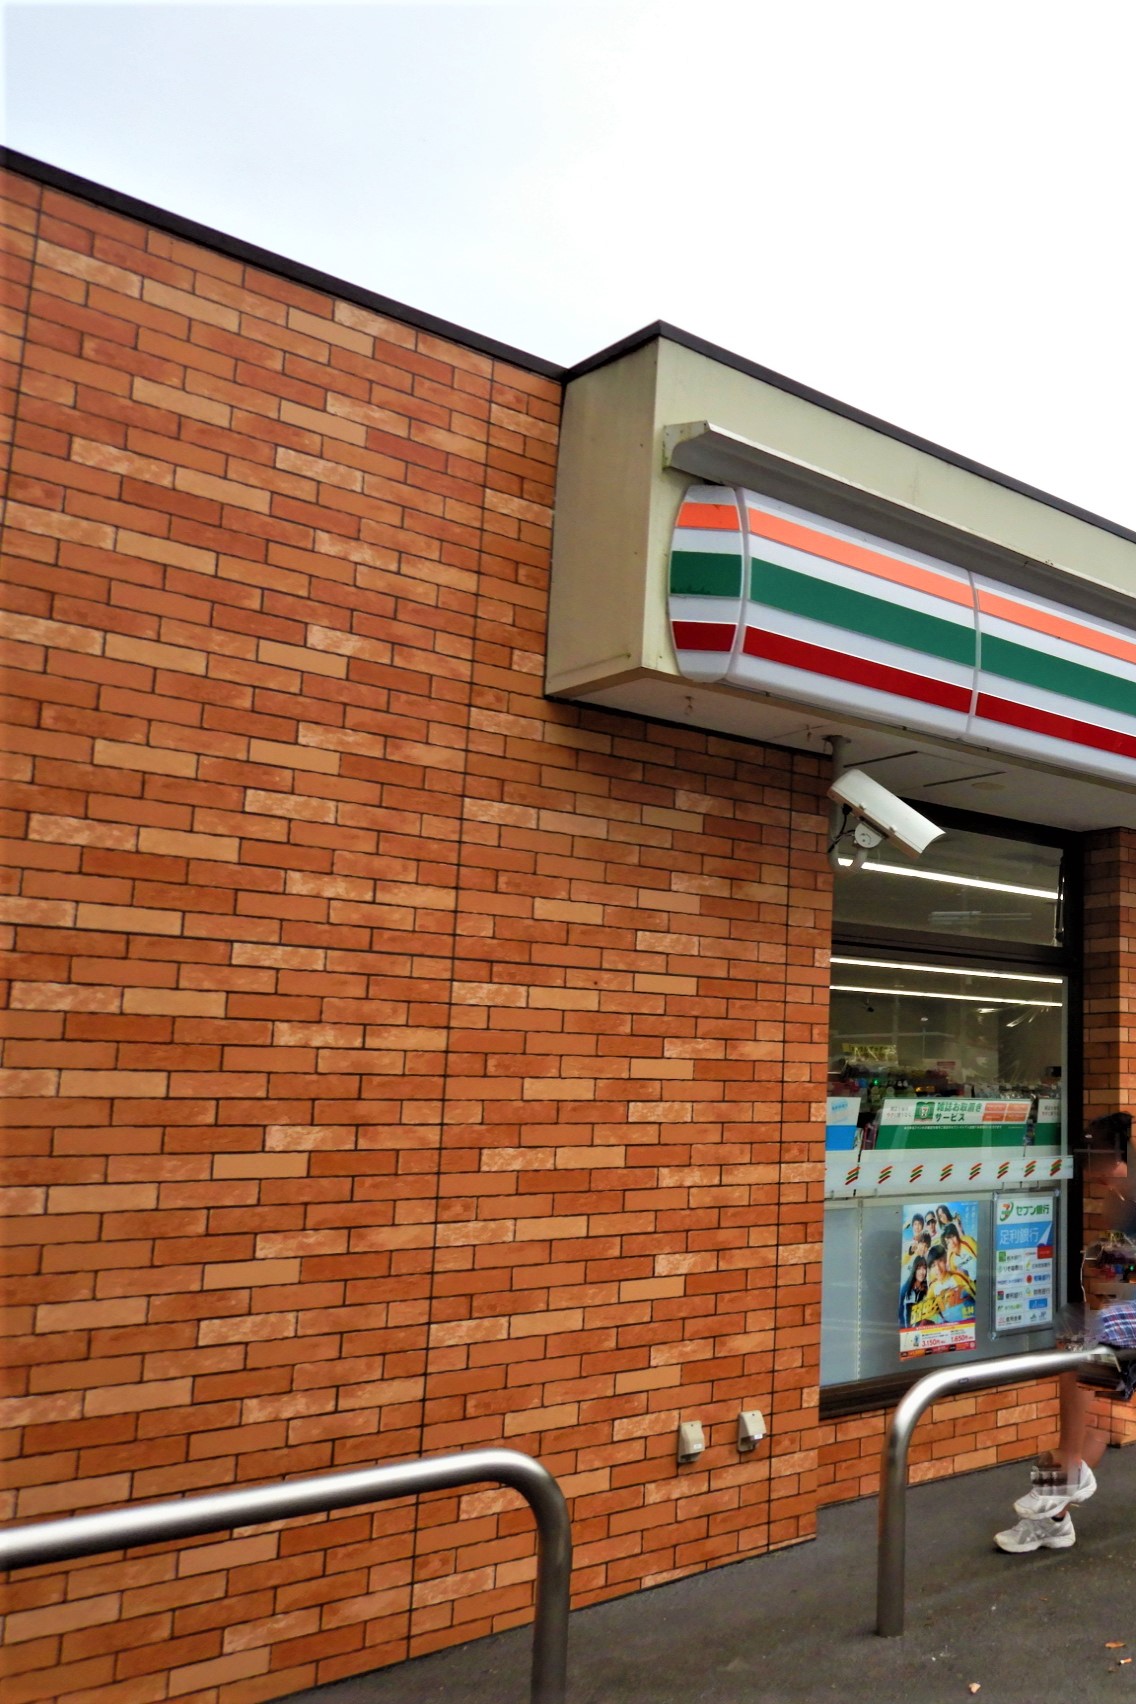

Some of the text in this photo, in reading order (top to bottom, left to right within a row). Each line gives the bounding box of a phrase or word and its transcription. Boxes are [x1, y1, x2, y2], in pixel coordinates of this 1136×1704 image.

[935, 1113, 966, 1123] サービス
[1016, 1204, 1050, 1216] セブン銀行
[999, 1227, 1040, 1246] 足利銀行
